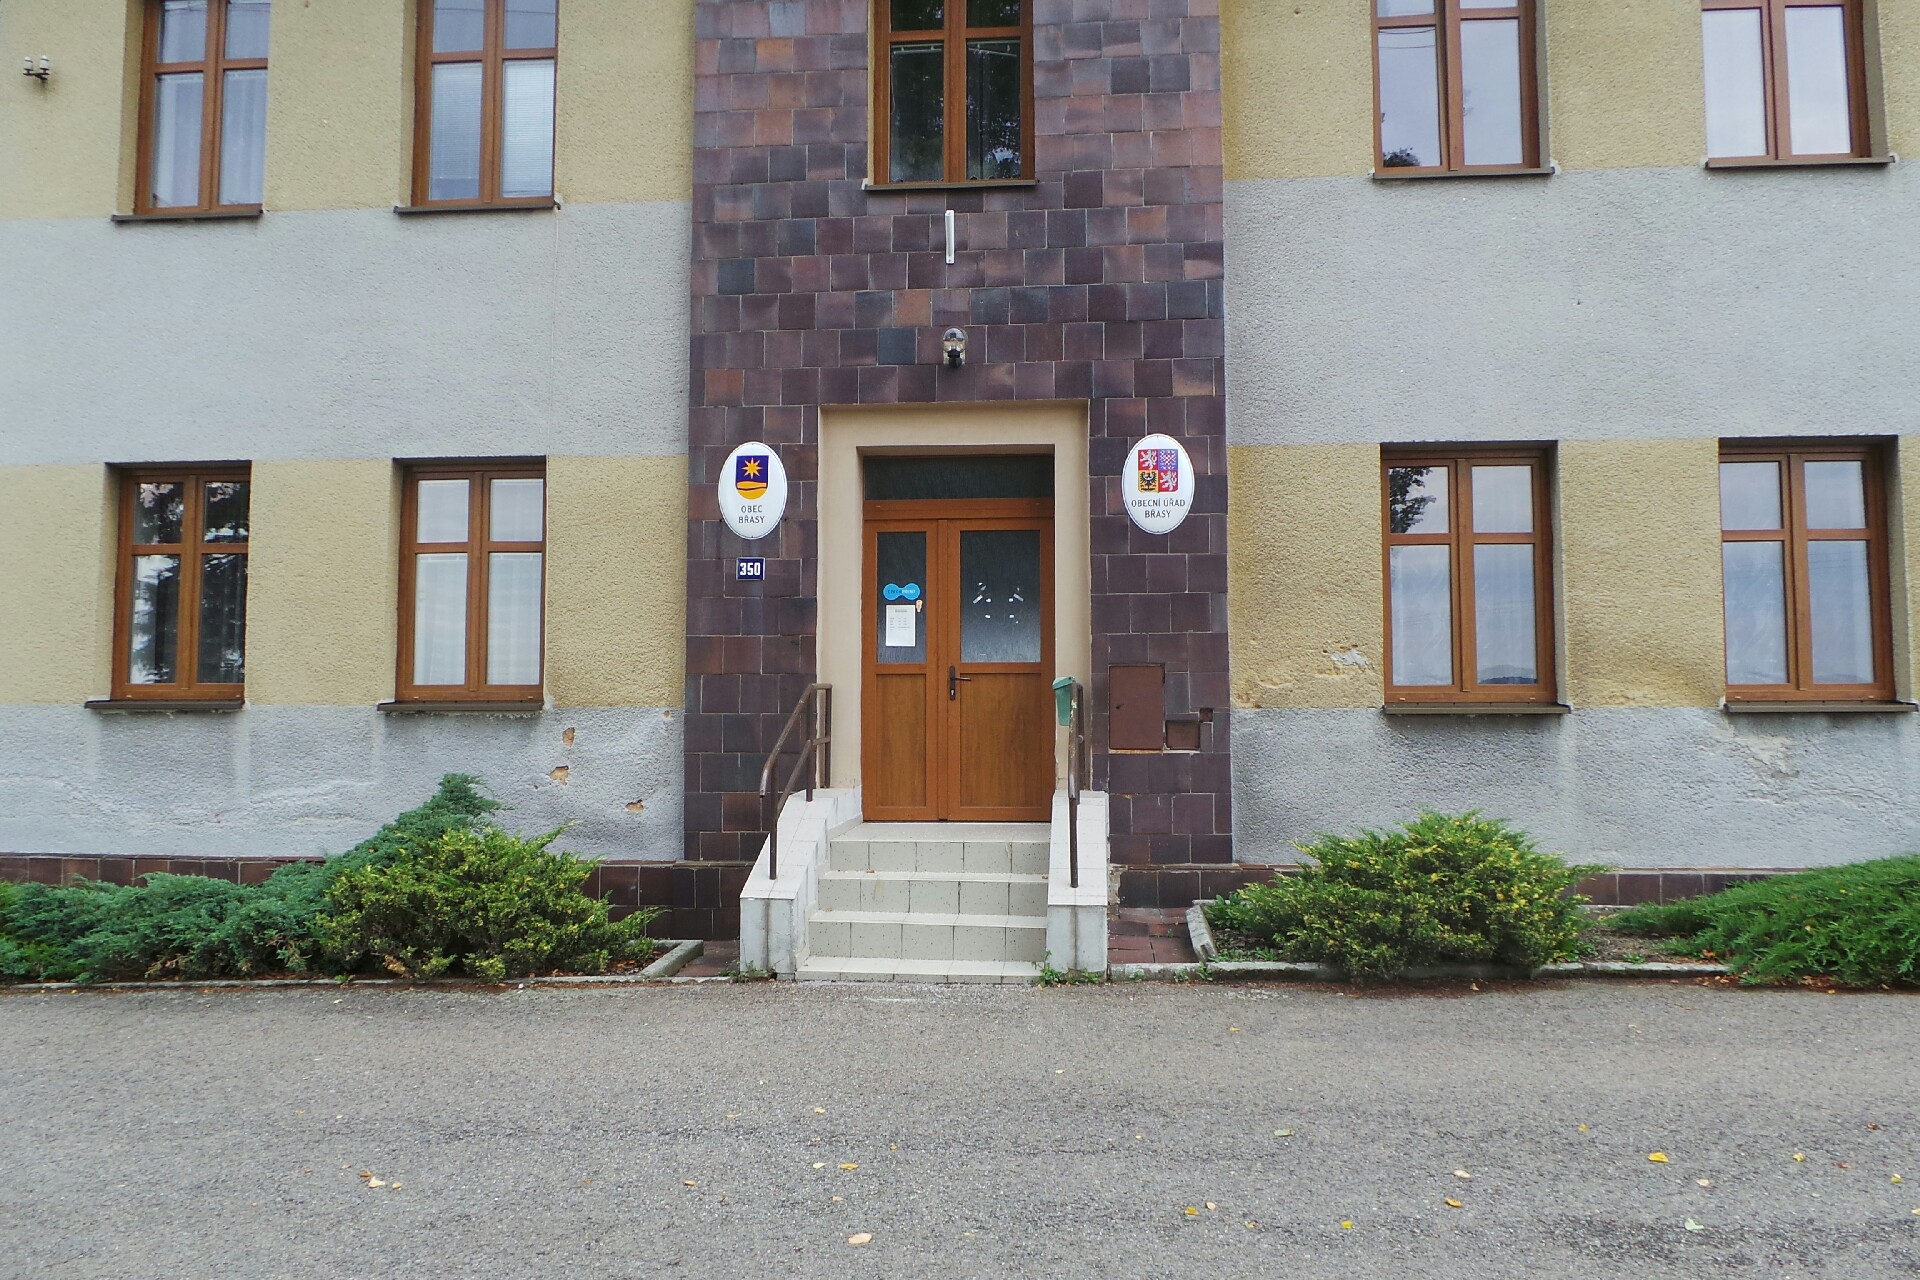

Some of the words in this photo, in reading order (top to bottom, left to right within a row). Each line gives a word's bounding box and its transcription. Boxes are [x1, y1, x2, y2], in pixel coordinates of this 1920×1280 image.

[1131, 498, 1161, 507] OBECNÍ
[1163, 498, 1186, 507] ÚŘAD
[740, 505, 763, 513] OBEC
[1144, 509, 1171, 518] BŘASY
[738, 515, 765, 523] BŘASY
[740, 562, 760, 575] 350
